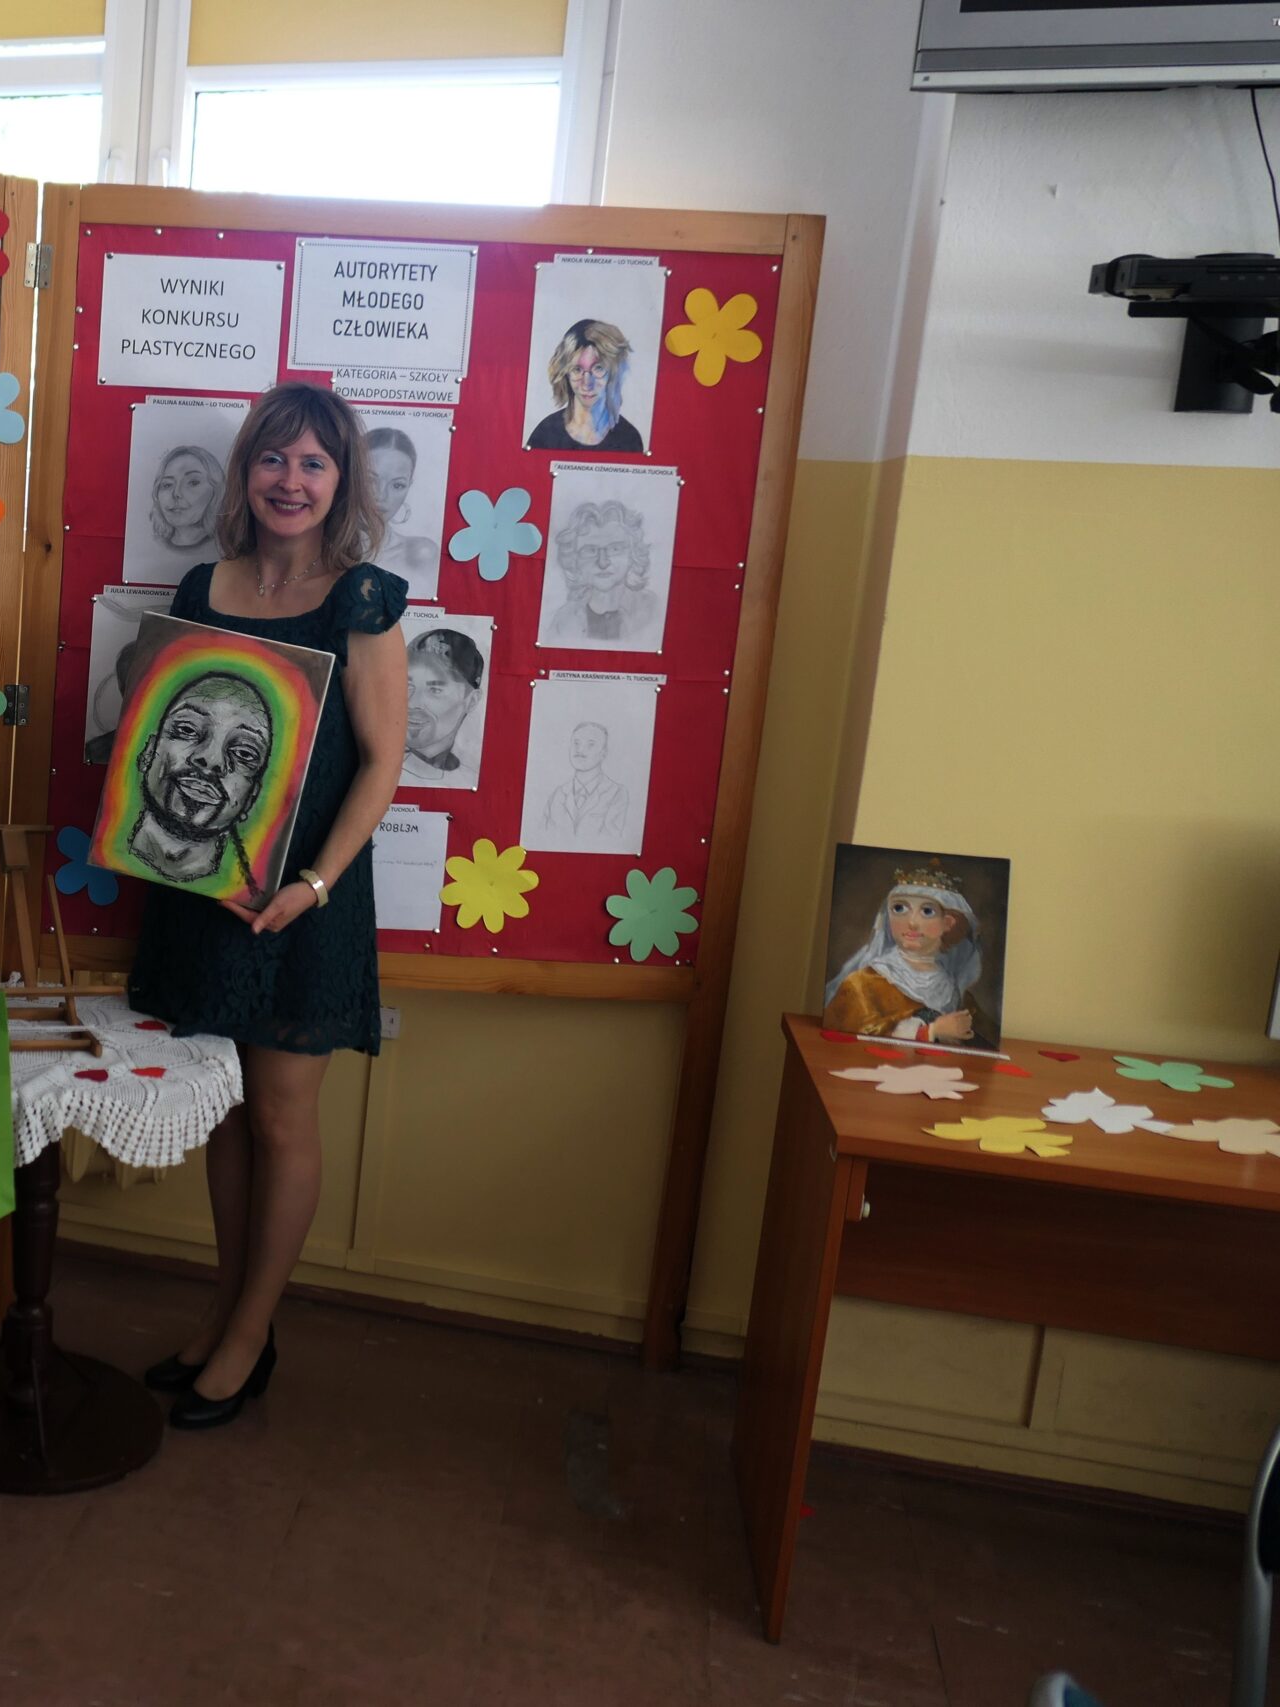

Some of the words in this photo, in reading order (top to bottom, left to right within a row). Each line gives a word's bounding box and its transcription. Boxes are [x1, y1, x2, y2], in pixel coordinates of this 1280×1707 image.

[333, 260, 438, 282] AUTORYTETY
[160, 277, 224, 297] WYNIKI
[342, 290, 424, 311] MŁODEGO
[141, 308, 239, 328] KONKURSU
[332, 319, 429, 340] CZŁOWIEKA
[121, 338, 256, 360] PLASTYCZNEGO
[336, 368, 397, 381] KATEGORIA
[409, 371, 449, 384] SZKOŁY
[335, 386, 454, 402] PONADPODSTAWOWE
[371, 409, 406, 417] SZYMAŃSKA
[557, 464, 593, 472] ALEKSANDRA
[126, 588, 170, 597] LEWANDOWSKA
[380, 821, 419, 833] RO8L3M
